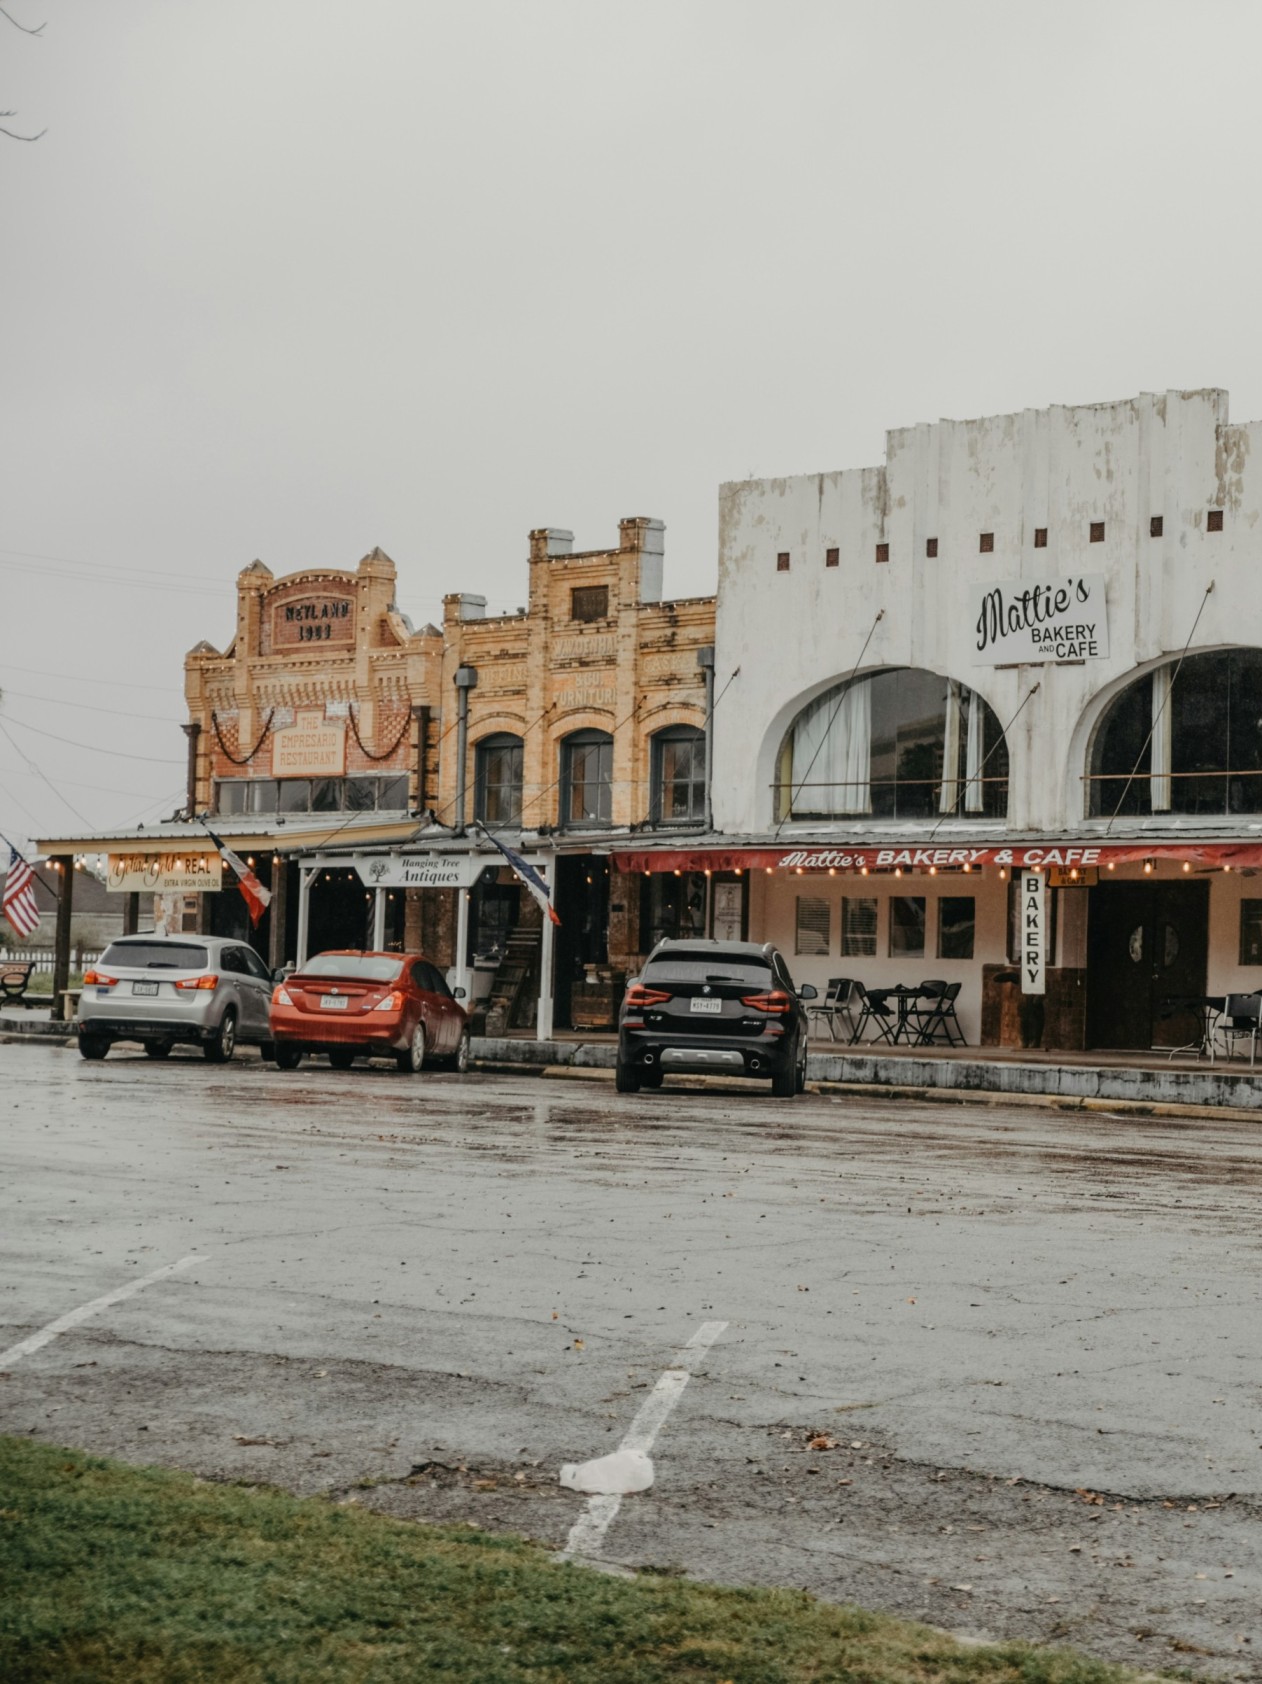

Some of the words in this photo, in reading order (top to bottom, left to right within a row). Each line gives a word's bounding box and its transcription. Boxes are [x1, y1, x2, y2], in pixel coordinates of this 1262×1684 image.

[977, 578, 1091, 651] Mattie's
[1031, 624, 1096, 643] BAKERY
[1039, 645, 1054, 653] AND
[1056, 641, 1098, 658] CAFE
[301, 716, 319, 730] THE
[281, 733, 336, 748] EMPRESARIO
[280, 751, 336, 766] RESTAURANT
[185, 858, 211, 874] REAL
[402, 859, 439, 868] Hanging
[441, 859, 460, 867] Tree
[778, 851, 865, 868] Mattie's
[876, 849, 988, 865] BAKERY
[994, 849, 1013, 864] &
[1022, 849, 1101, 865] CAFE
[164, 879, 179, 887] EXTRA
[181, 879, 196, 887] VIRGIN
[197, 879, 210, 887] OLIVE
[400, 869, 460, 885] Antiques
[1026, 878, 1039, 983] BAKERY
